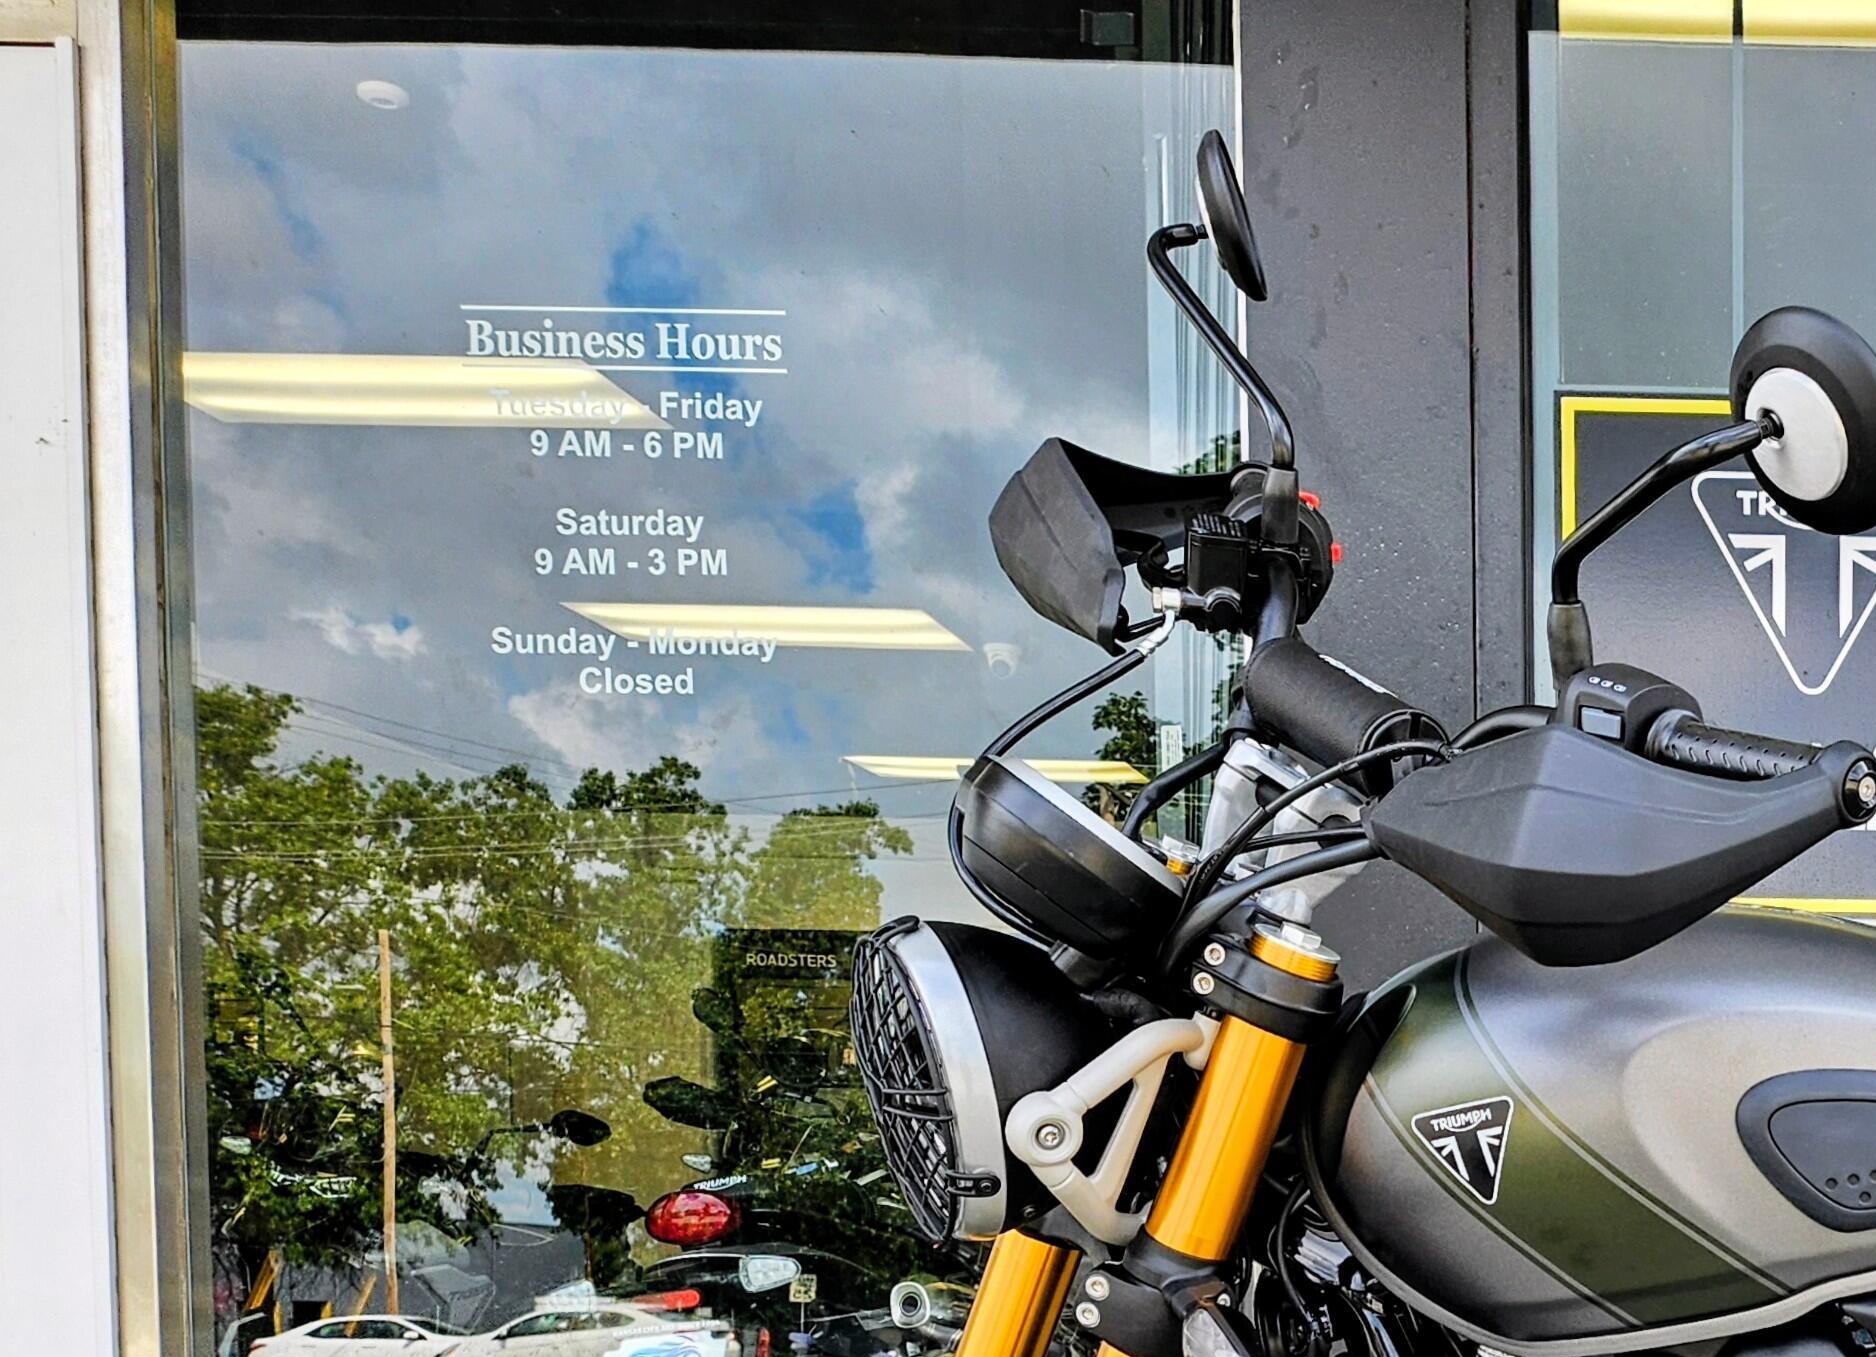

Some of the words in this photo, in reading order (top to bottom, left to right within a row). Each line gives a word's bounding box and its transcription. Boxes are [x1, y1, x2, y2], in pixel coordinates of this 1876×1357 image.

[465, 319, 646, 360] Business
[656, 322, 783, 362] Hours
[490, 389, 627, 425] Tuesday
[660, 391, 763, 427] Friday
[530, 429, 549, 456] 9
[558, 430, 612, 457] AM
[643, 431, 662, 458] 6
[674, 432, 724, 459] PM
[556, 508, 704, 543] Saturday
[534, 548, 553, 575] 9
[562, 549, 616, 575] AM
[648, 549, 667, 576] 3
[678, 549, 728, 576] PM
[490, 626, 616, 660] Sunday
[649, 629, 778, 663] Monday
[579, 667, 694, 695] Closed
[746, 953, 837, 968] ROADSTERS
[1430, 1107, 1493, 1132] TRIUMPH
[693, 1174, 747, 1191] TRIUMPH
